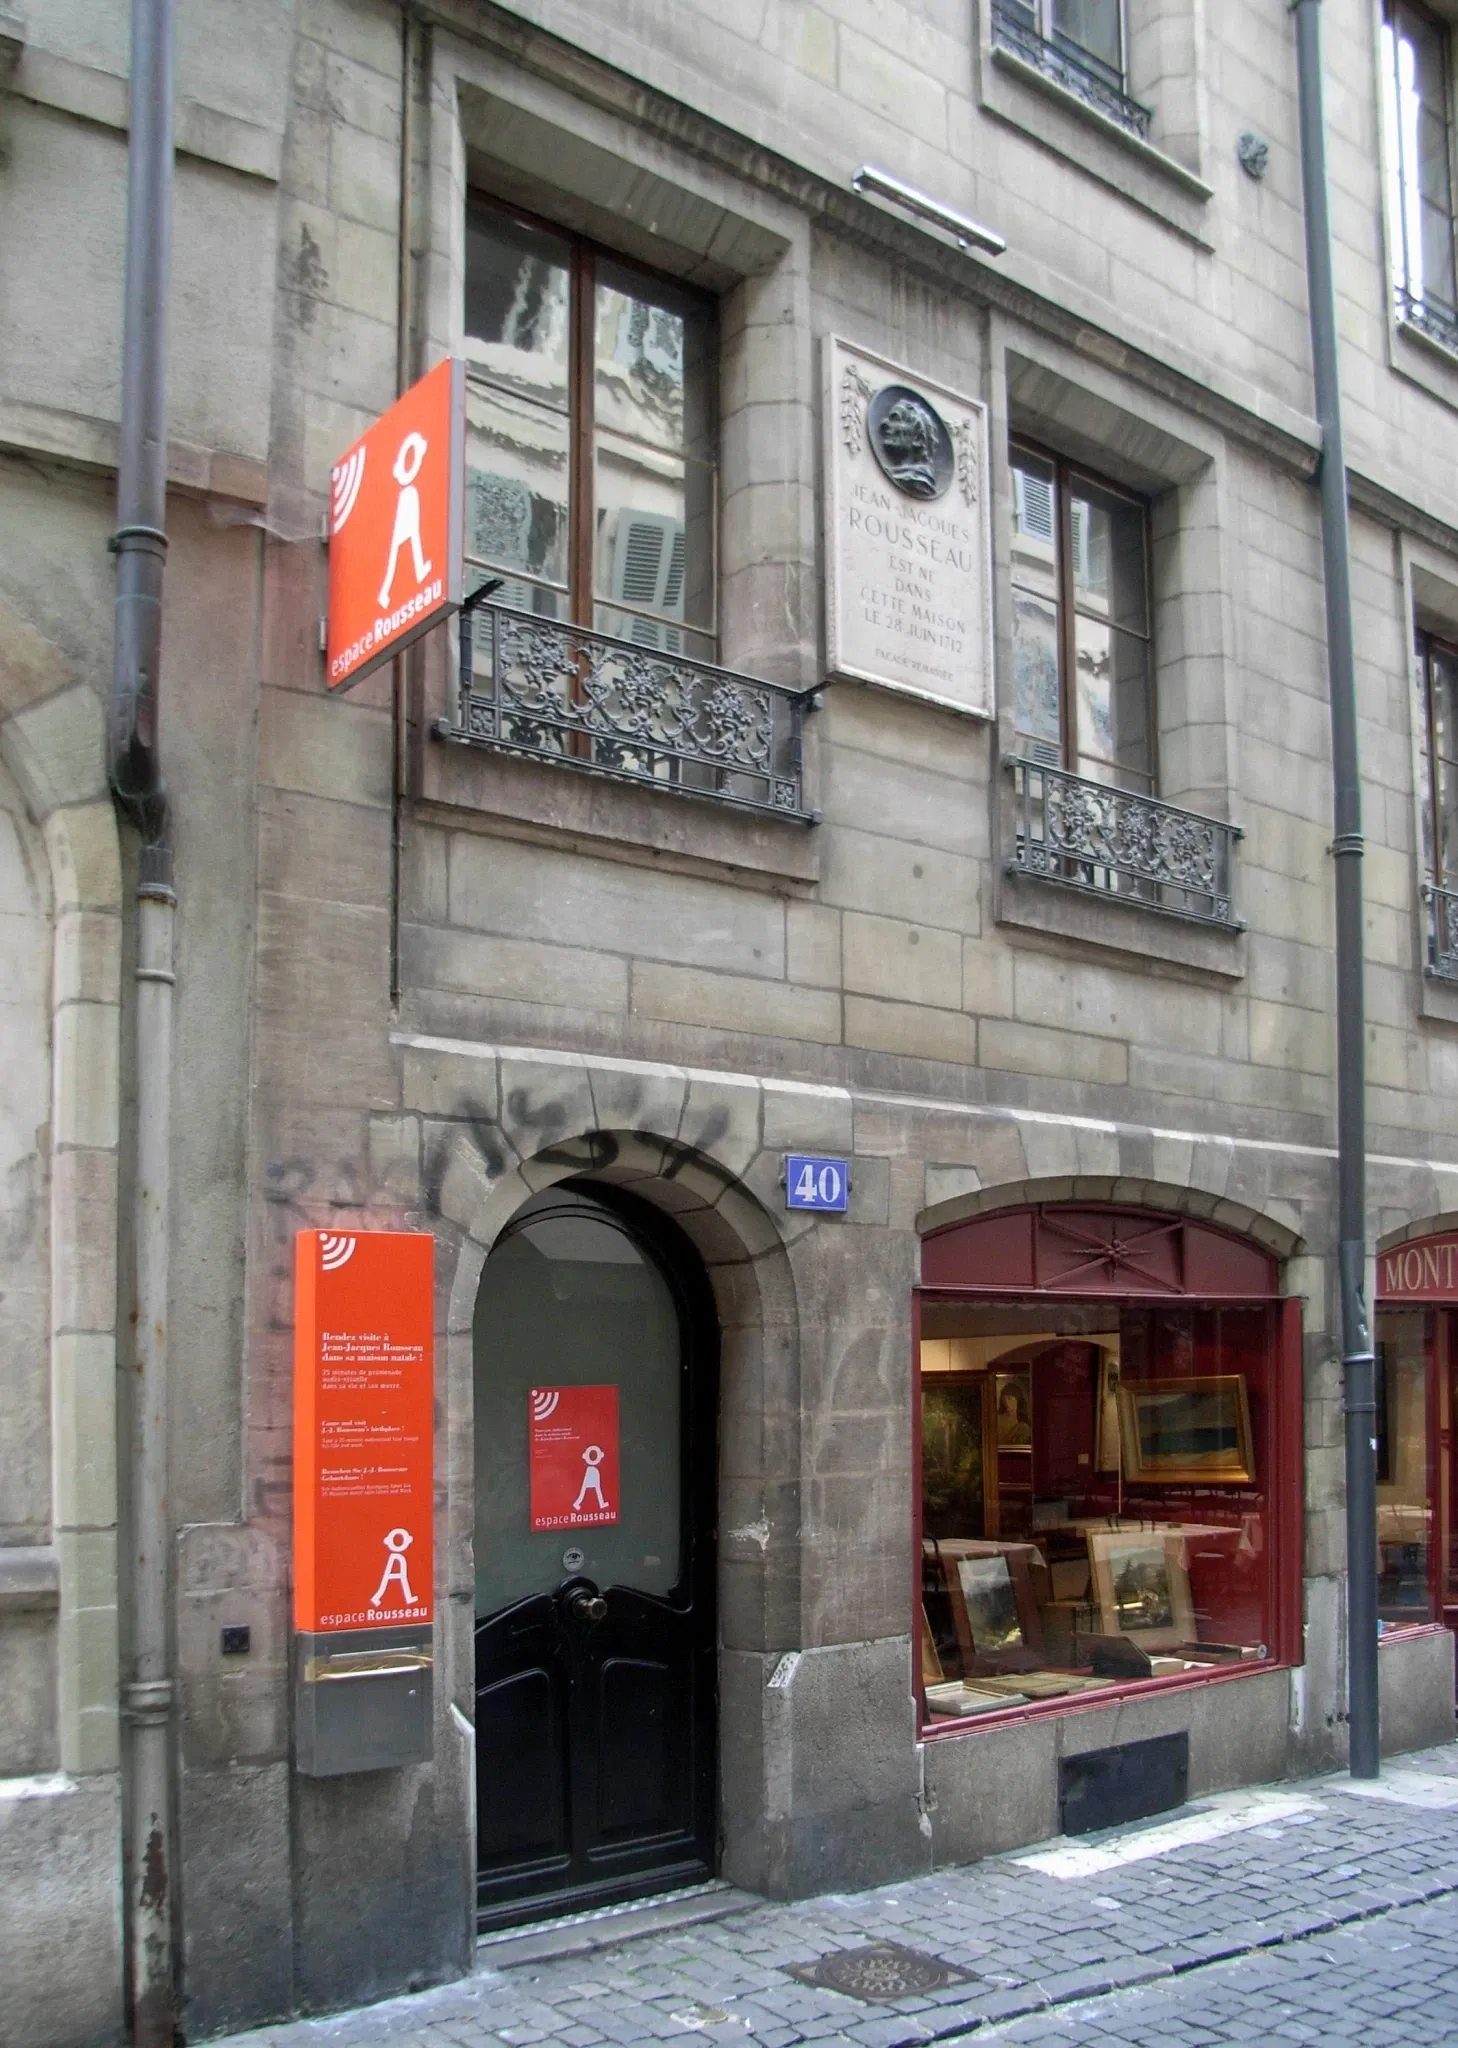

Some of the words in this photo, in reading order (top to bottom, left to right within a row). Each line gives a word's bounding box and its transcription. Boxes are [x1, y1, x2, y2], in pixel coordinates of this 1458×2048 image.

[850, 507, 972, 573] ROUSSEAU
[889, 555, 913, 575] EST
[895, 579, 932, 602] DANS
[860, 587, 906, 614] CETTE
[912, 603, 966, 634] MAISON
[864, 607, 881, 626] LE
[886, 615, 902, 632] 28
[906, 623, 937, 644] JUIN
[939, 634, 962, 654] 1712
[794, 1164, 841, 1203] 40
[321, 1342, 381, 1353] Jean-Jacques
[382, 1342, 424, 1352] Rousseau
[322, 1332, 356, 1341] Rendez
[358, 1333, 381, 1341] visite
[321, 1352, 344, 1361] dans
[357, 1353, 389, 1361] maison
[391, 1353, 417, 1361] natale
